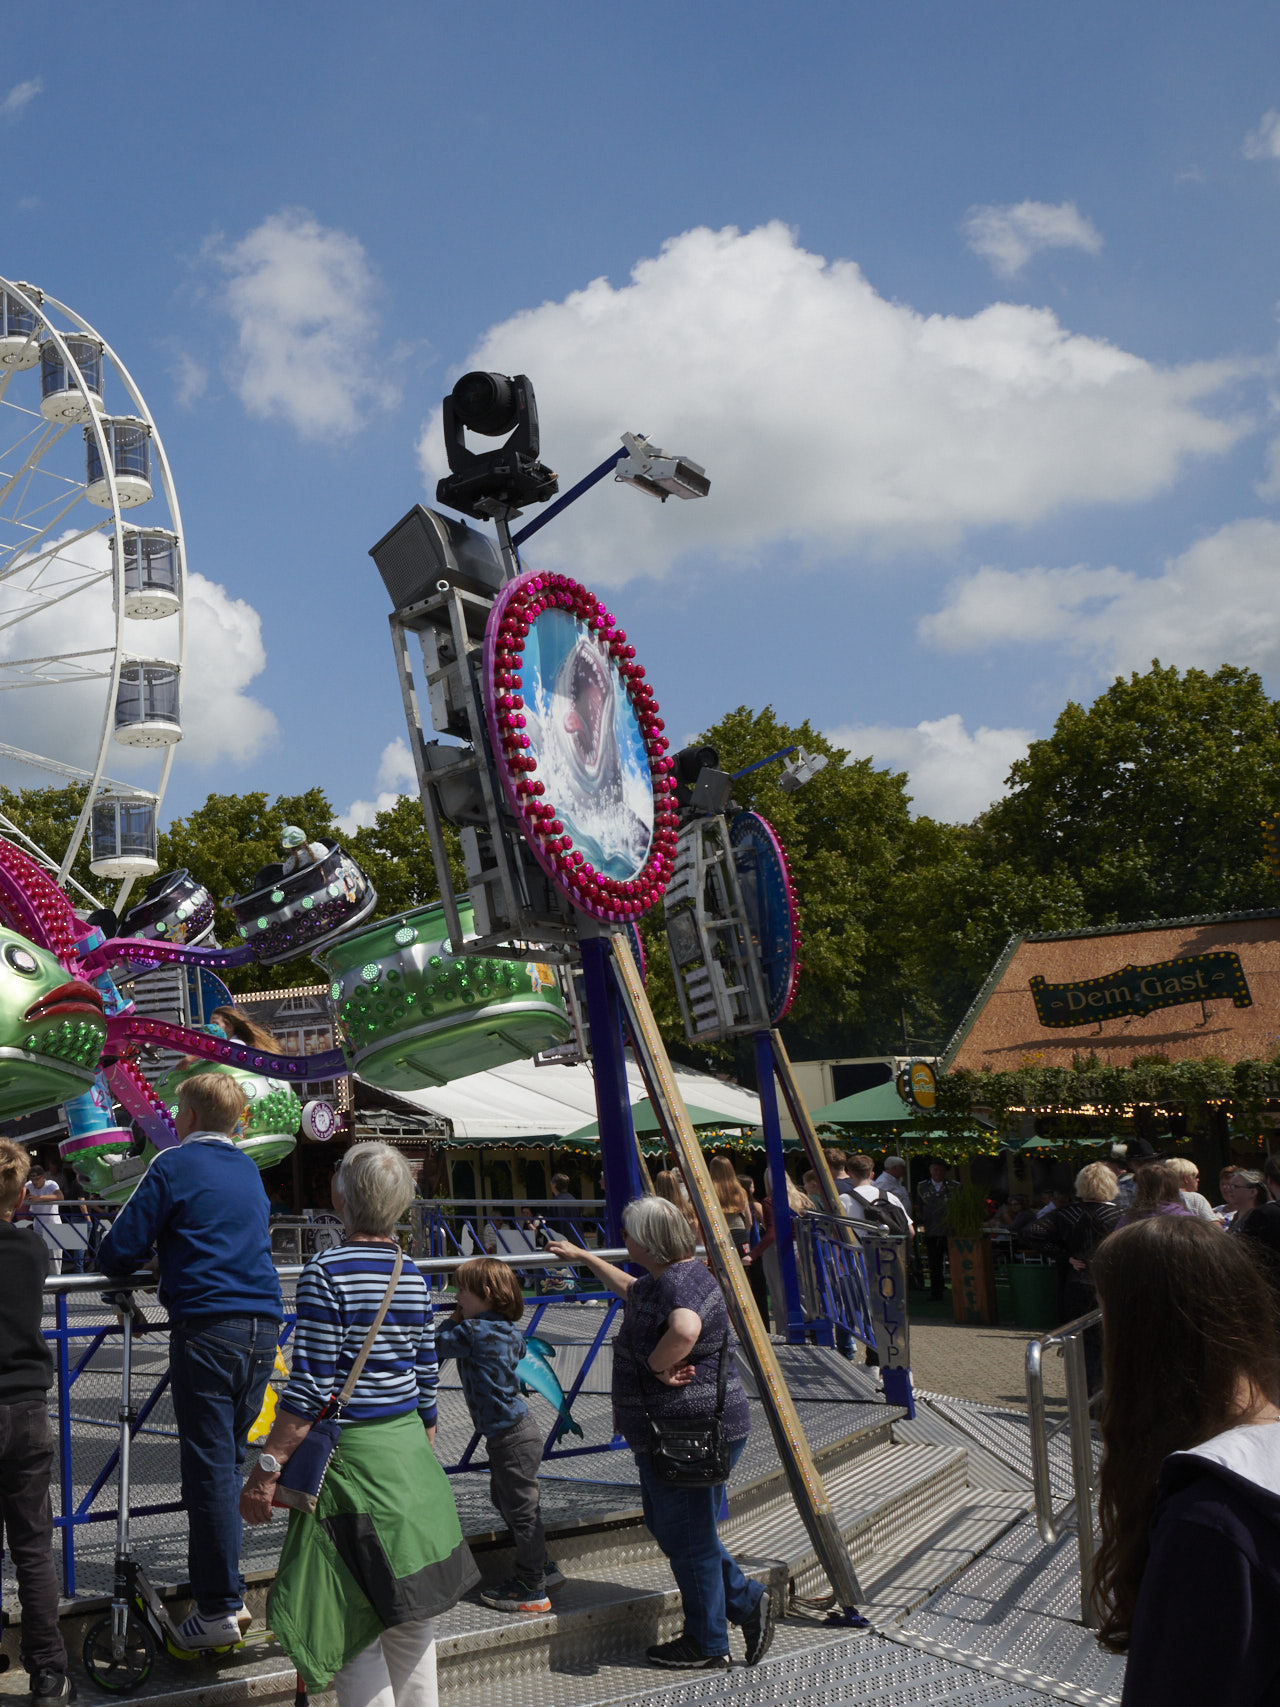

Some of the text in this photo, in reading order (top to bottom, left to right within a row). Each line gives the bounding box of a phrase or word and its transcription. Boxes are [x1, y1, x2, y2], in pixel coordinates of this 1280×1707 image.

[1066, 968, 1209, 1012] Dem Gast
[875, 1247, 900, 1364] POLYP
